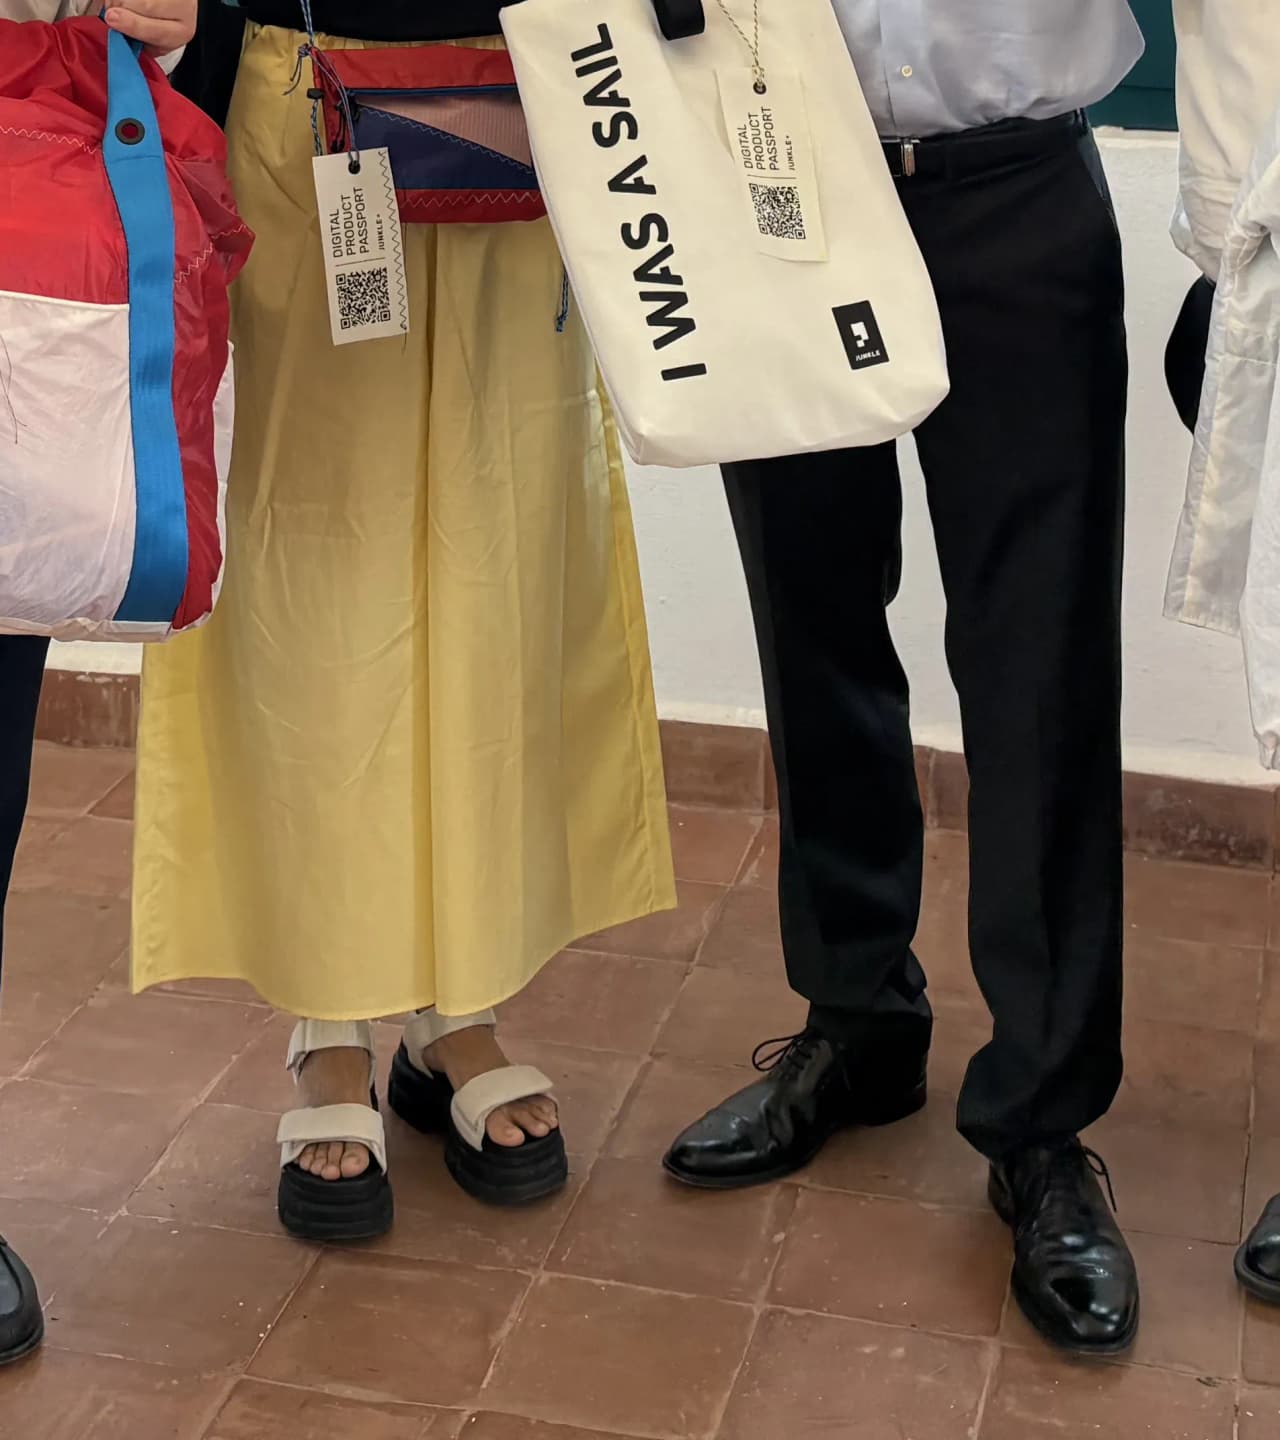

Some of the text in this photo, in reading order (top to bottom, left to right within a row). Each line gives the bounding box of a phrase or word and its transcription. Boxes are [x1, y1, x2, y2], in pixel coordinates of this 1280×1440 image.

[737, 124, 754, 169] DIGITAL
[748, 112, 766, 170] PRODUCT
[761, 106, 780, 171] PASSPORT
[341, 194, 357, 256] PRODUCT
[353, 186, 370, 254] PASSPORT
[570, 22, 707, 381] I WAS A SAIL
[329, 208, 343, 258] DIGITAL
